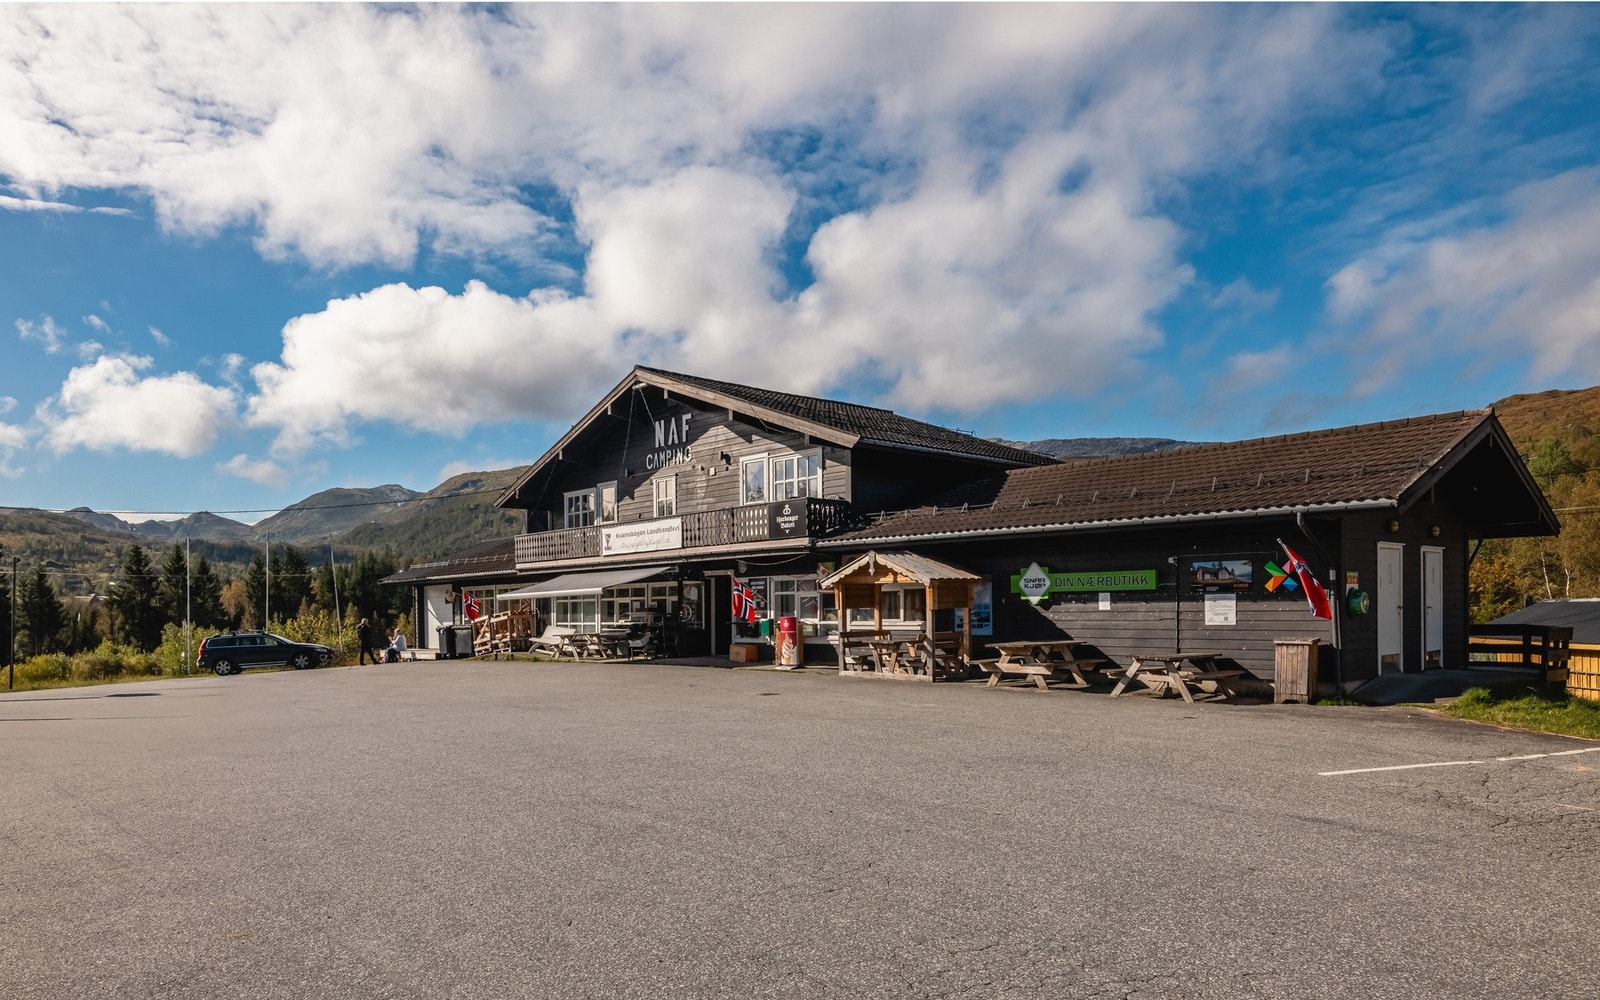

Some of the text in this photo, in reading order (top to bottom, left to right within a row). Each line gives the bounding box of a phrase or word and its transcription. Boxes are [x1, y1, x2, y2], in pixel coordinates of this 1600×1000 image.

[655, 413, 691, 448] NAF
[646, 446, 692, 469] CAMPING
[1055, 575, 1149, 588] DIN NÆRBUTIKK
